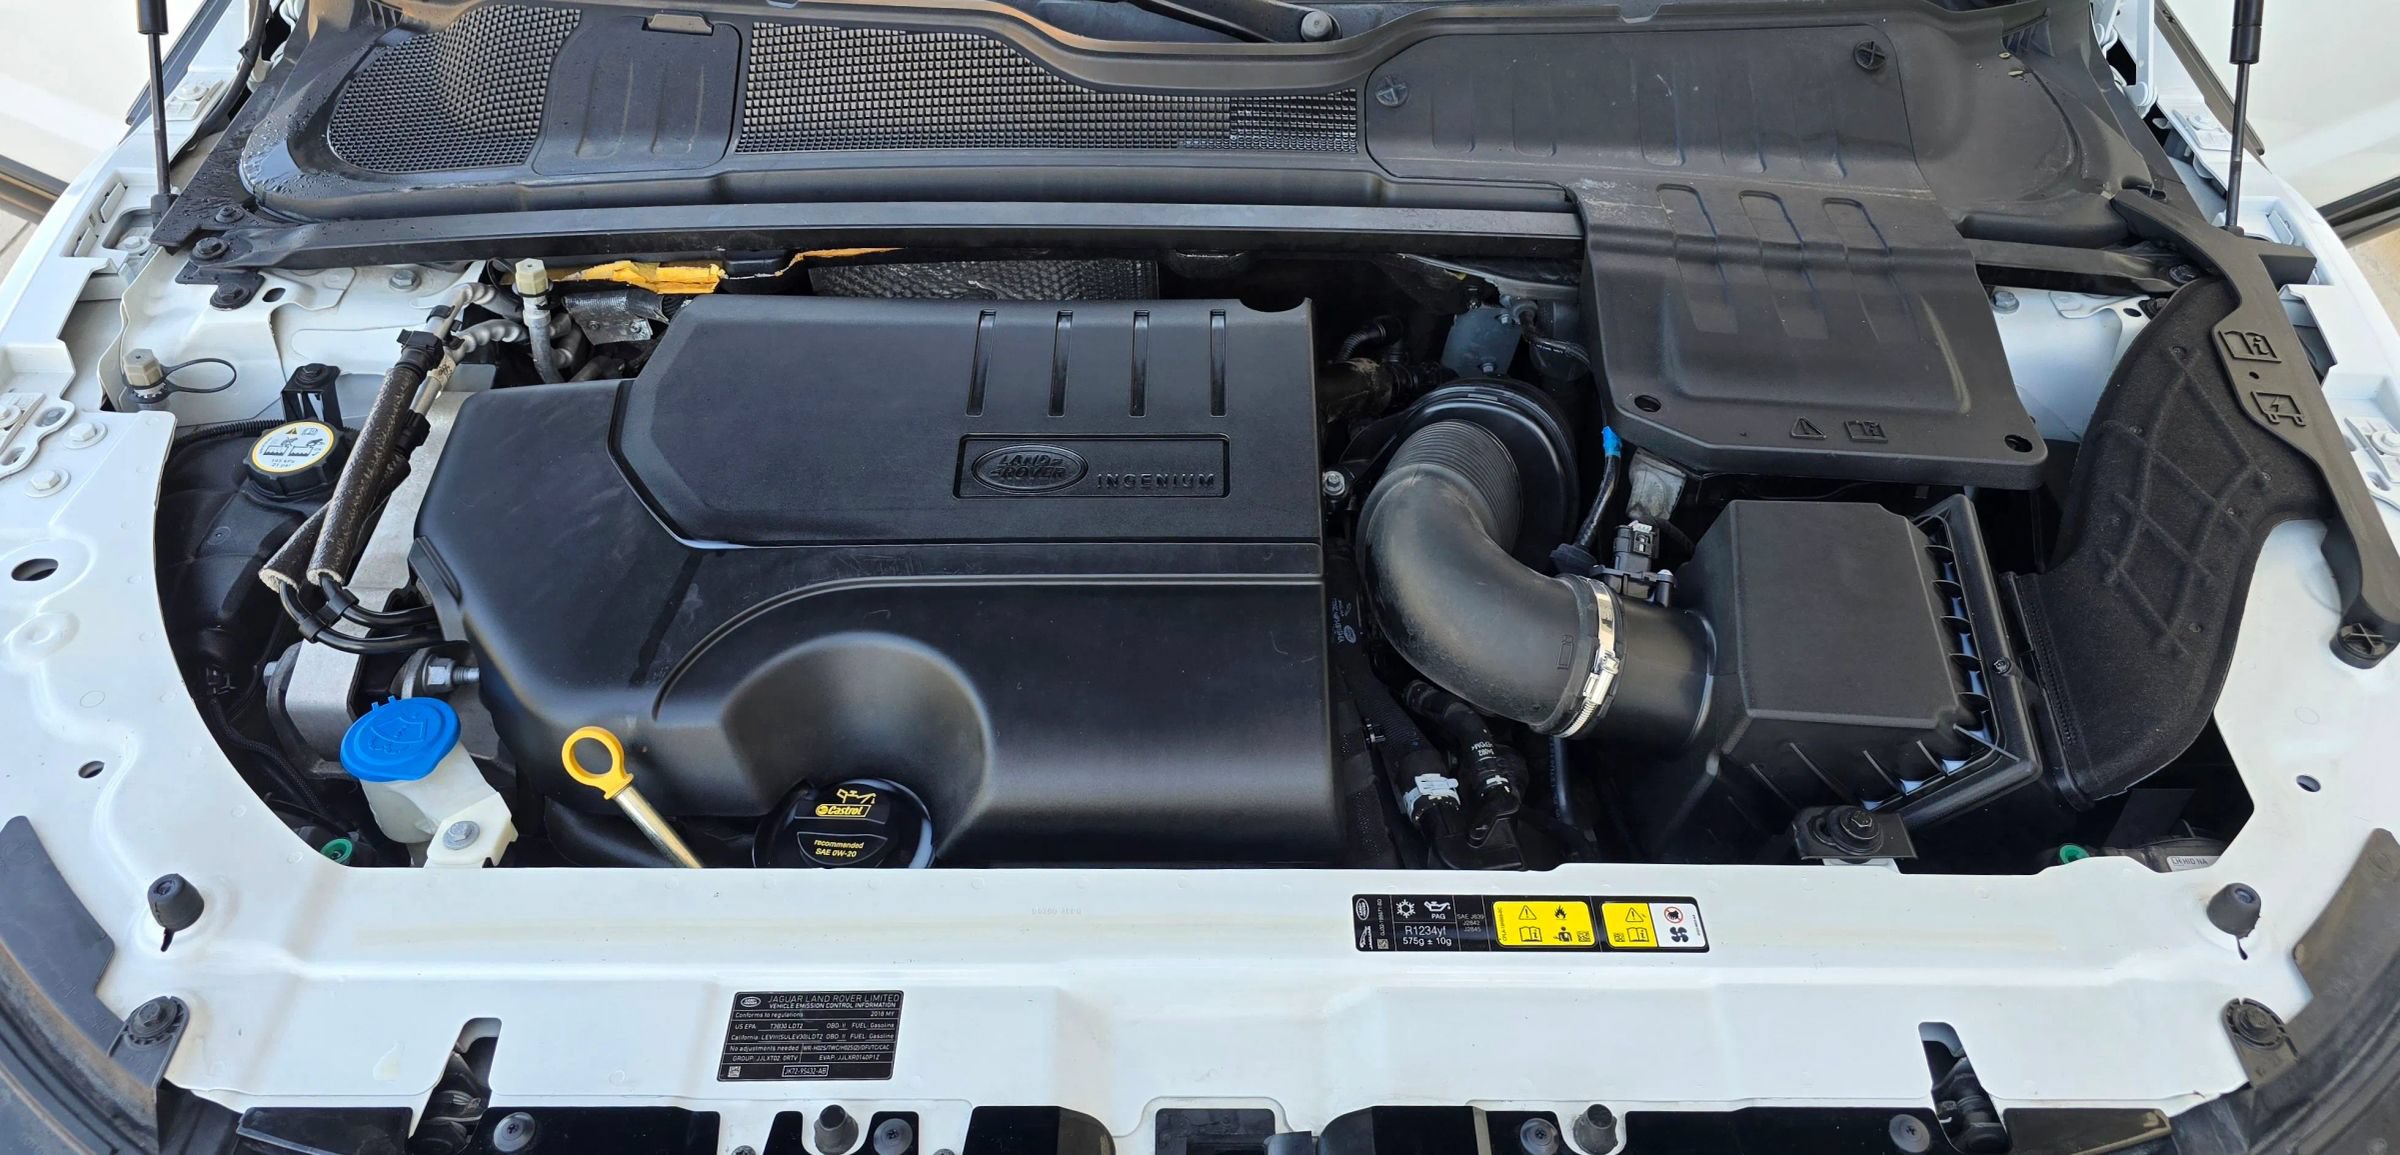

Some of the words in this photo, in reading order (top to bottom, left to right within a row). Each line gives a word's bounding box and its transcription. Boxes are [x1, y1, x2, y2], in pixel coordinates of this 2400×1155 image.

[999, 454, 1050, 466] LAND
[1001, 467, 1066, 479] ROVER
[1096, 472, 1216, 489] INGENIUM
[827, 805, 863, 815] Castrol
[814, 839, 865, 849] recommended
[815, 848, 831, 856] SAE
[832, 849, 857, 858] 0W-20
[1404, 926, 1447, 938] R1234yf
[1403, 938, 1425, 947] 575g
[1436, 938, 1452, 947] 10g
[768, 995, 804, 1003] JAGUAR
[805, 995, 830, 1003] LAND
[832, 994, 862, 1002] ROVER
[864, 994, 900, 1002] LIMITED
